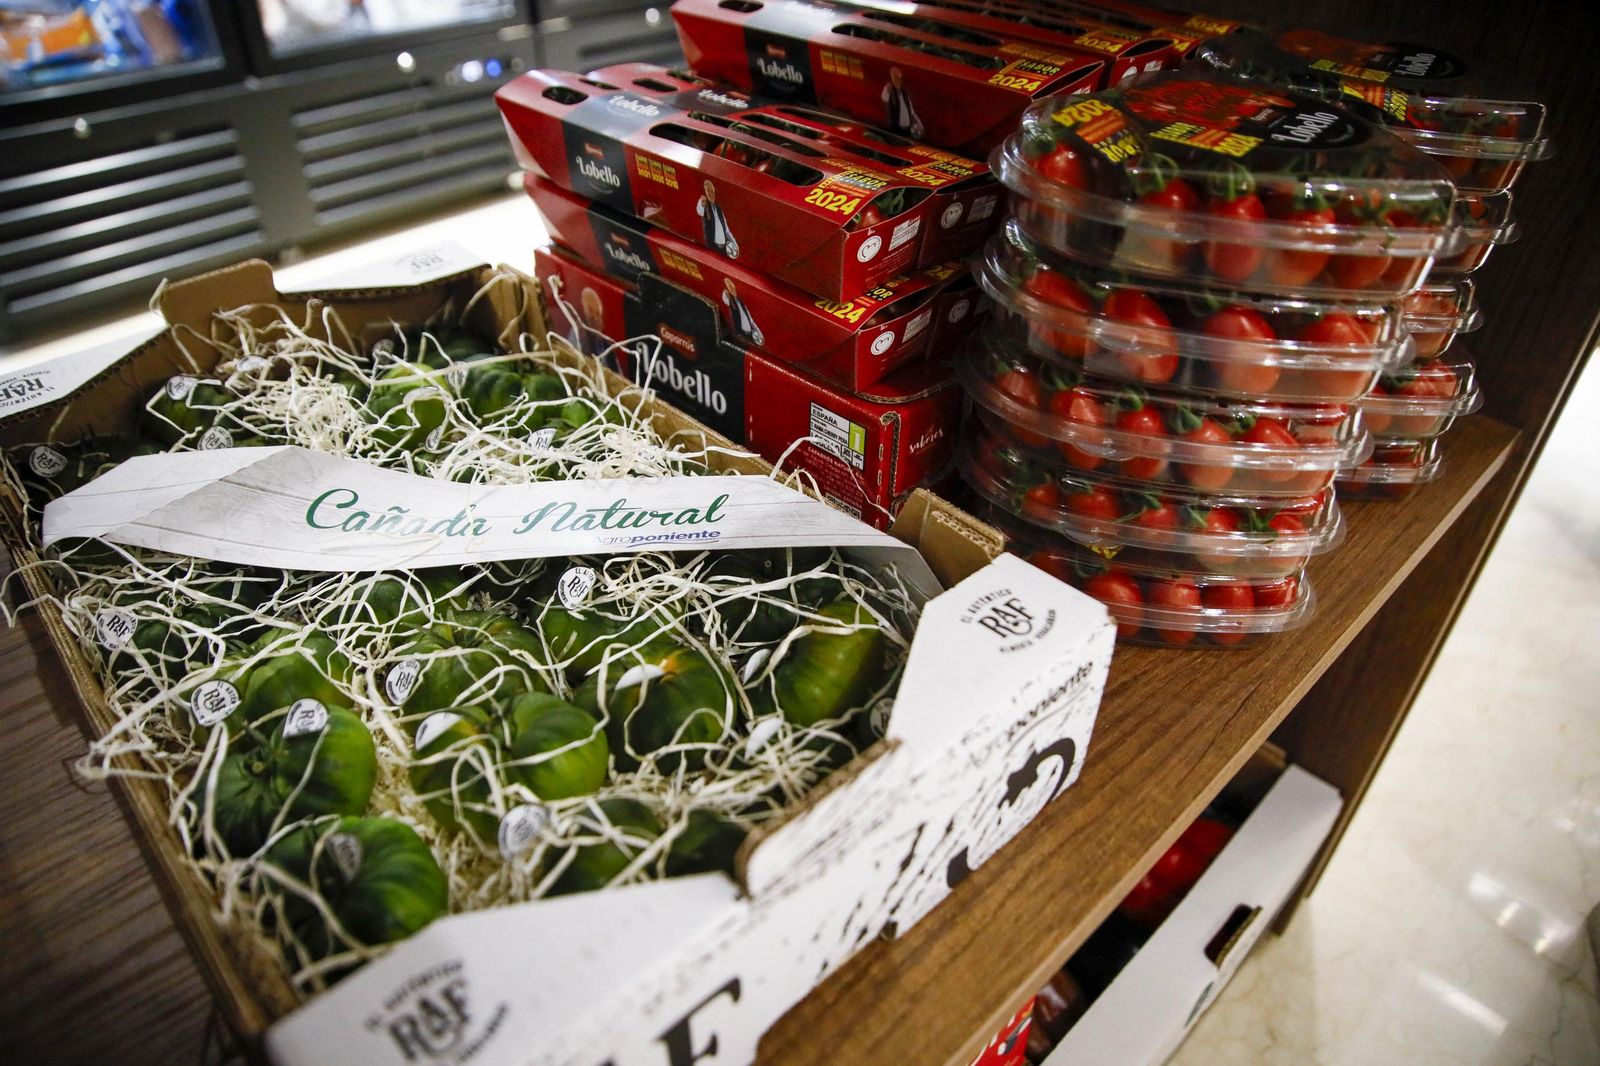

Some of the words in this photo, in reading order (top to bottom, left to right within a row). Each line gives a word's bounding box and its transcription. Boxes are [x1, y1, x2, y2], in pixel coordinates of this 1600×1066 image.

[757, 57, 804, 84] Lobello
[988, 73, 1042, 92] 2024
[608, 94, 661, 118] Lobello
[698, 88, 749, 110] Lobello
[1271, 111, 1340, 144] Lobello
[576, 155, 621, 188] Lobello
[896, 167, 948, 187] 2024
[804, 189, 862, 216] 2024
[604, 241, 651, 272] Lobello
[635, 341, 727, 415] Lobello
[812, 408, 838, 426] ESPAÑA
[36, 452, 61, 470] RAF
[306, 488, 492, 537] Cañada
[512, 493, 730, 535] Natural
[106, 614, 130, 638] RAF
[977, 597, 1034, 638] RAF
[395, 671, 415, 693] RAF
[203, 688, 227, 714] RAF
[388, 978, 470, 1062] RAF
